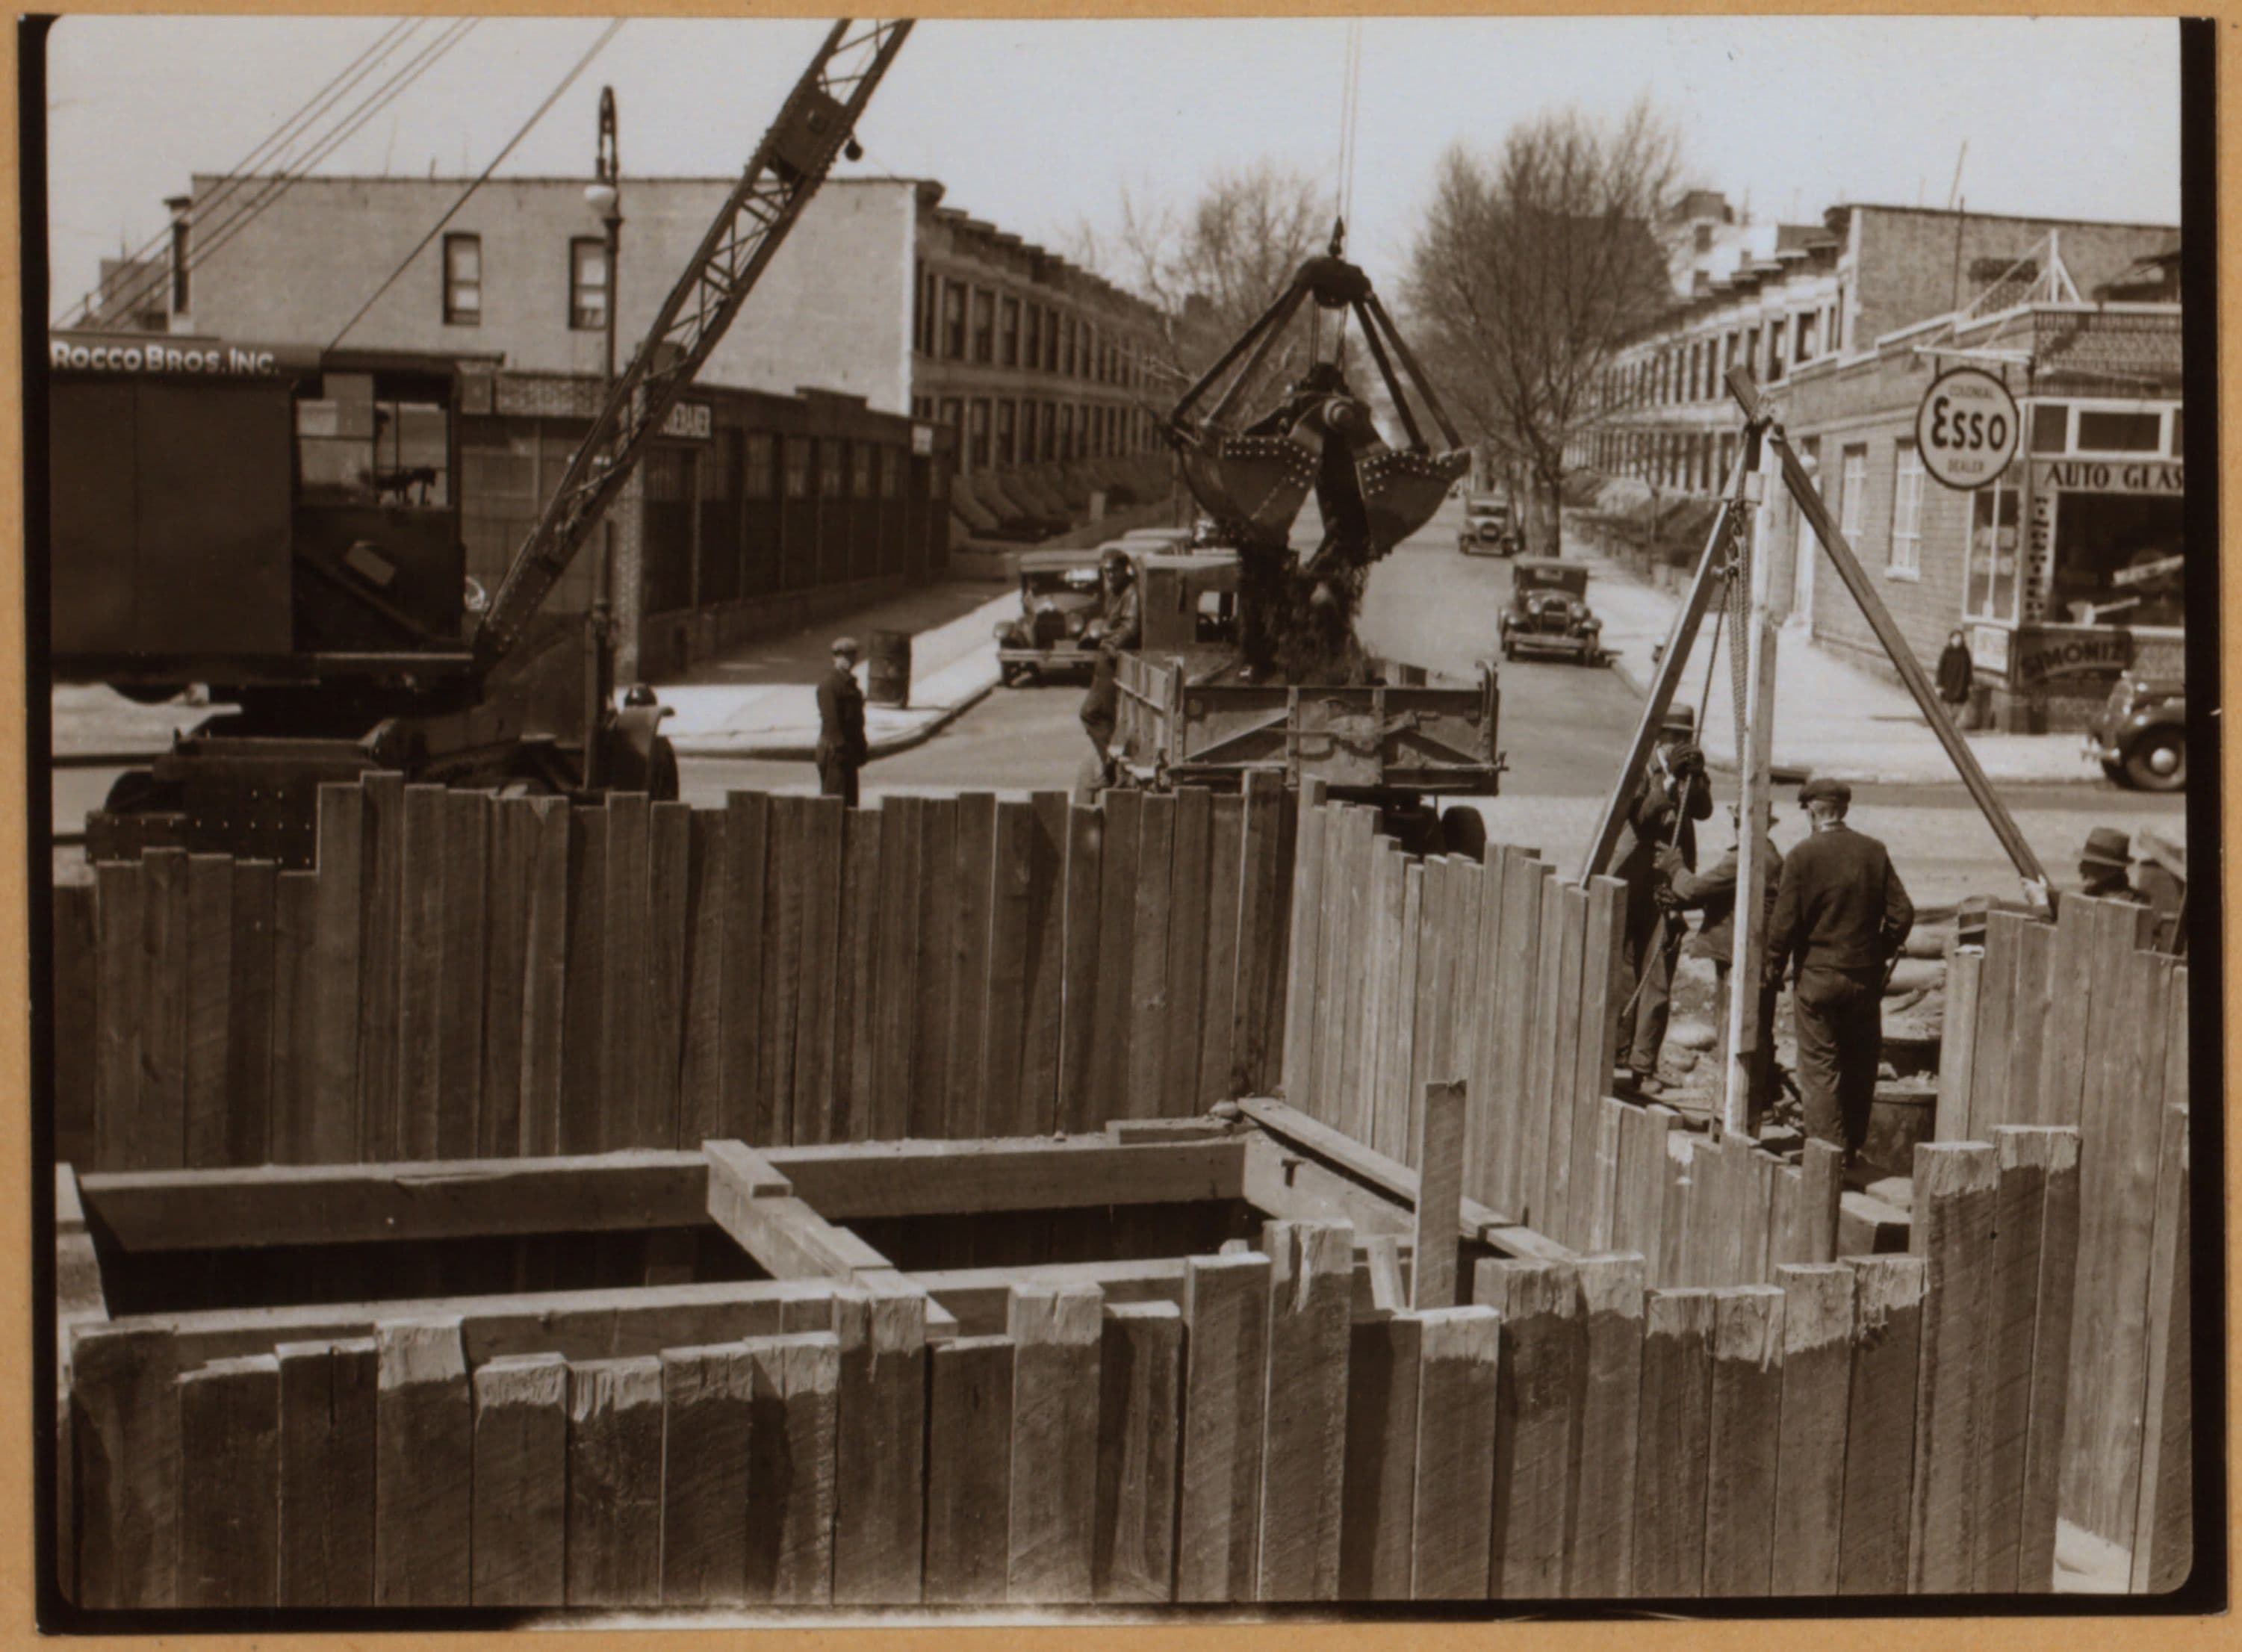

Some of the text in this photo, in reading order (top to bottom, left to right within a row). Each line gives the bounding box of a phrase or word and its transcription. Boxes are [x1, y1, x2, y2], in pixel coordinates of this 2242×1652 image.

[49, 341, 281, 377] ROCCO BROS. INC.
[1931, 394, 2007, 453] ESSO
[2043, 462, 2110, 489] AUTO
